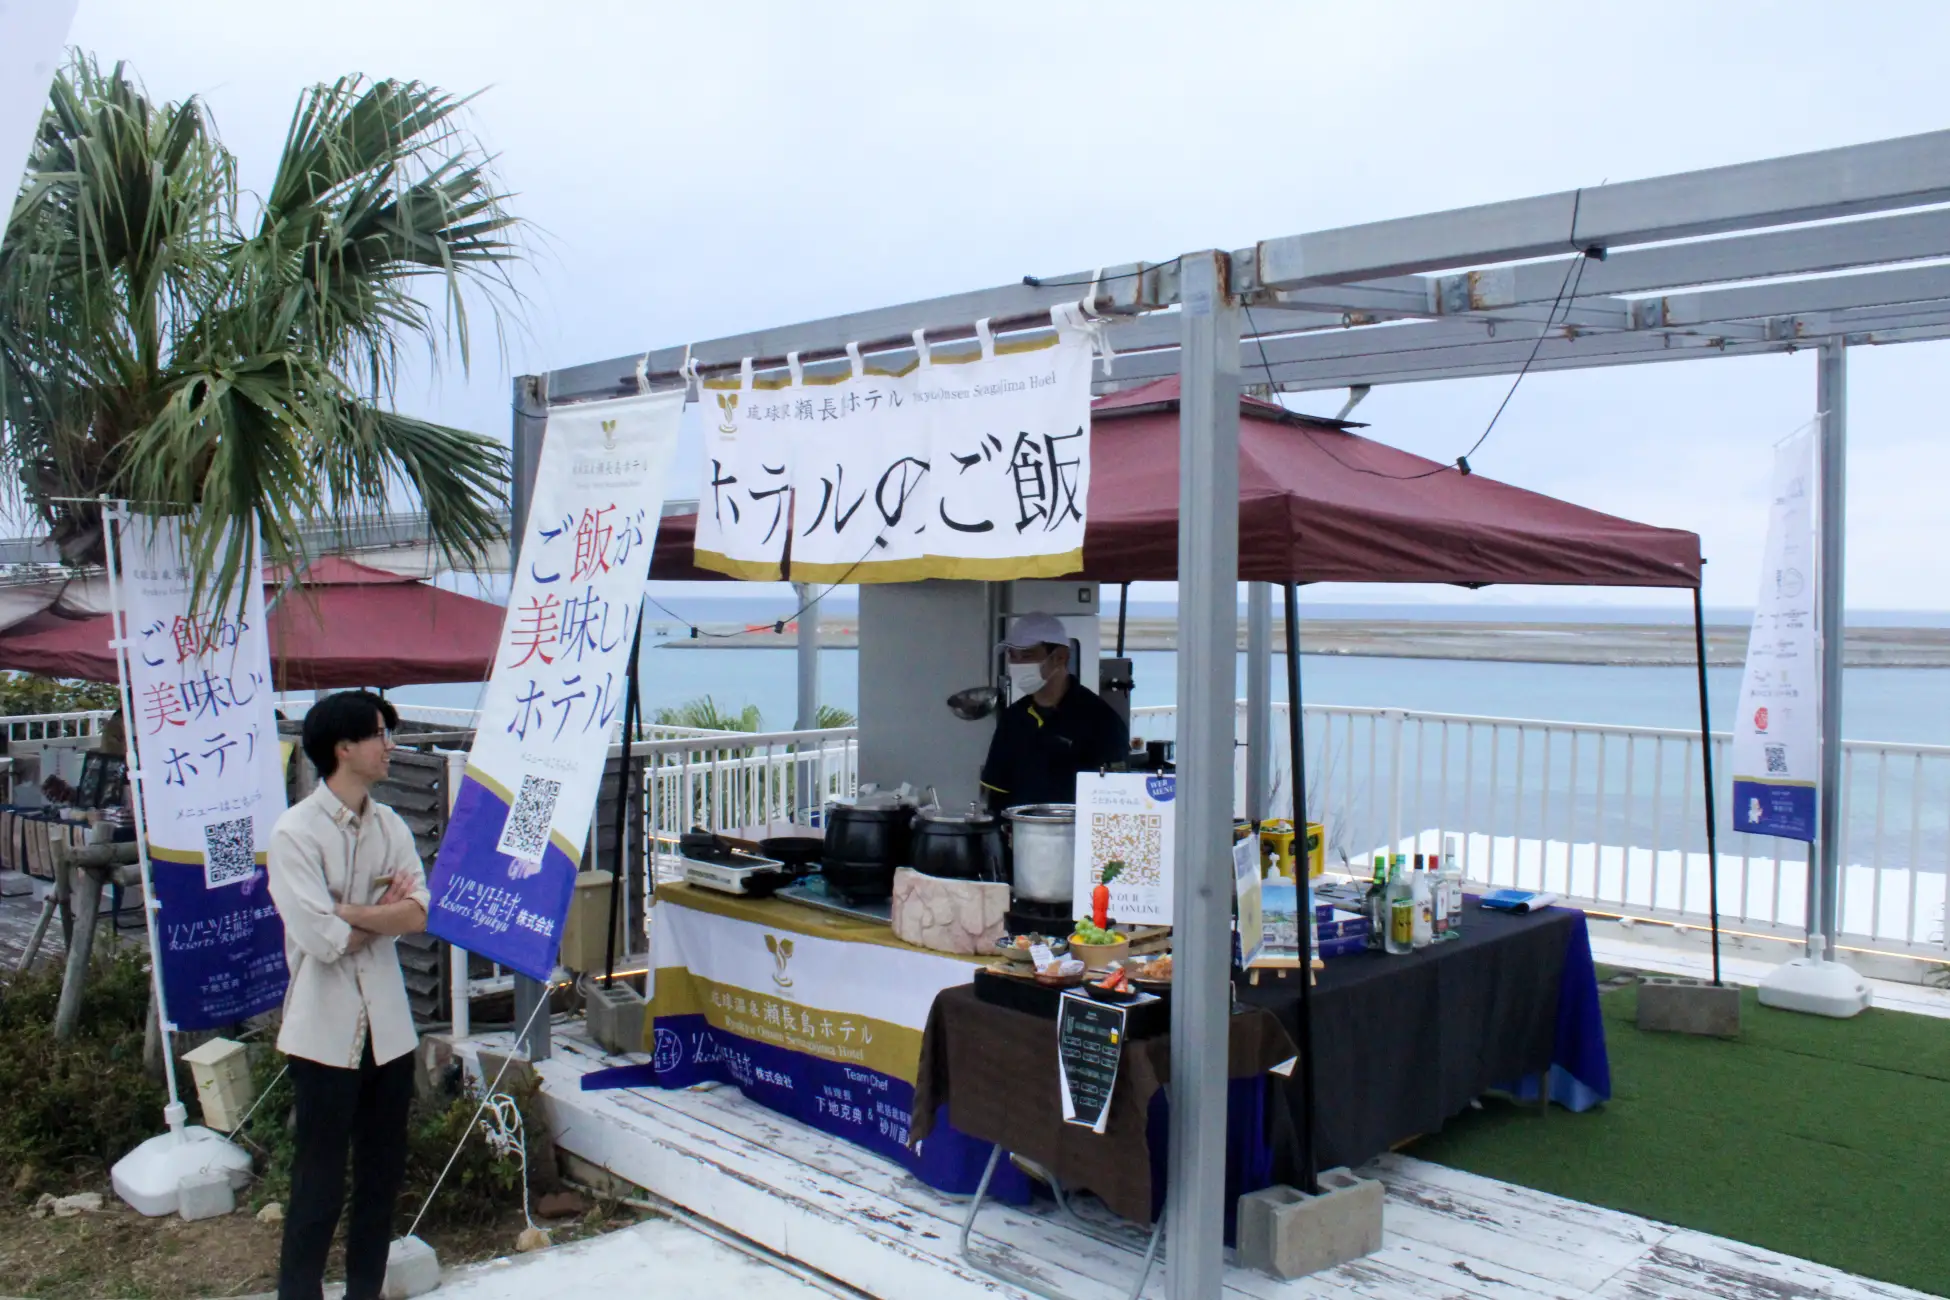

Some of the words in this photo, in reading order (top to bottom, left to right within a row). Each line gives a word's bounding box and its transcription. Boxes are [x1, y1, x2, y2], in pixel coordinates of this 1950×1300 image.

[710, 425, 1083, 545] ホテルのご飯
[532, 503, 645, 584] ご飯が
[507, 585, 639, 670] 美味しい
[507, 672, 619, 743] ホテル
[1150, 779, 1168, 789] WEB
[1121, 904, 1160, 914] ONLINE
[844, 1067, 869, 1084] Team
[869, 1074, 889, 1091] Chef
[815, 1095, 863, 1125] 下地克典
